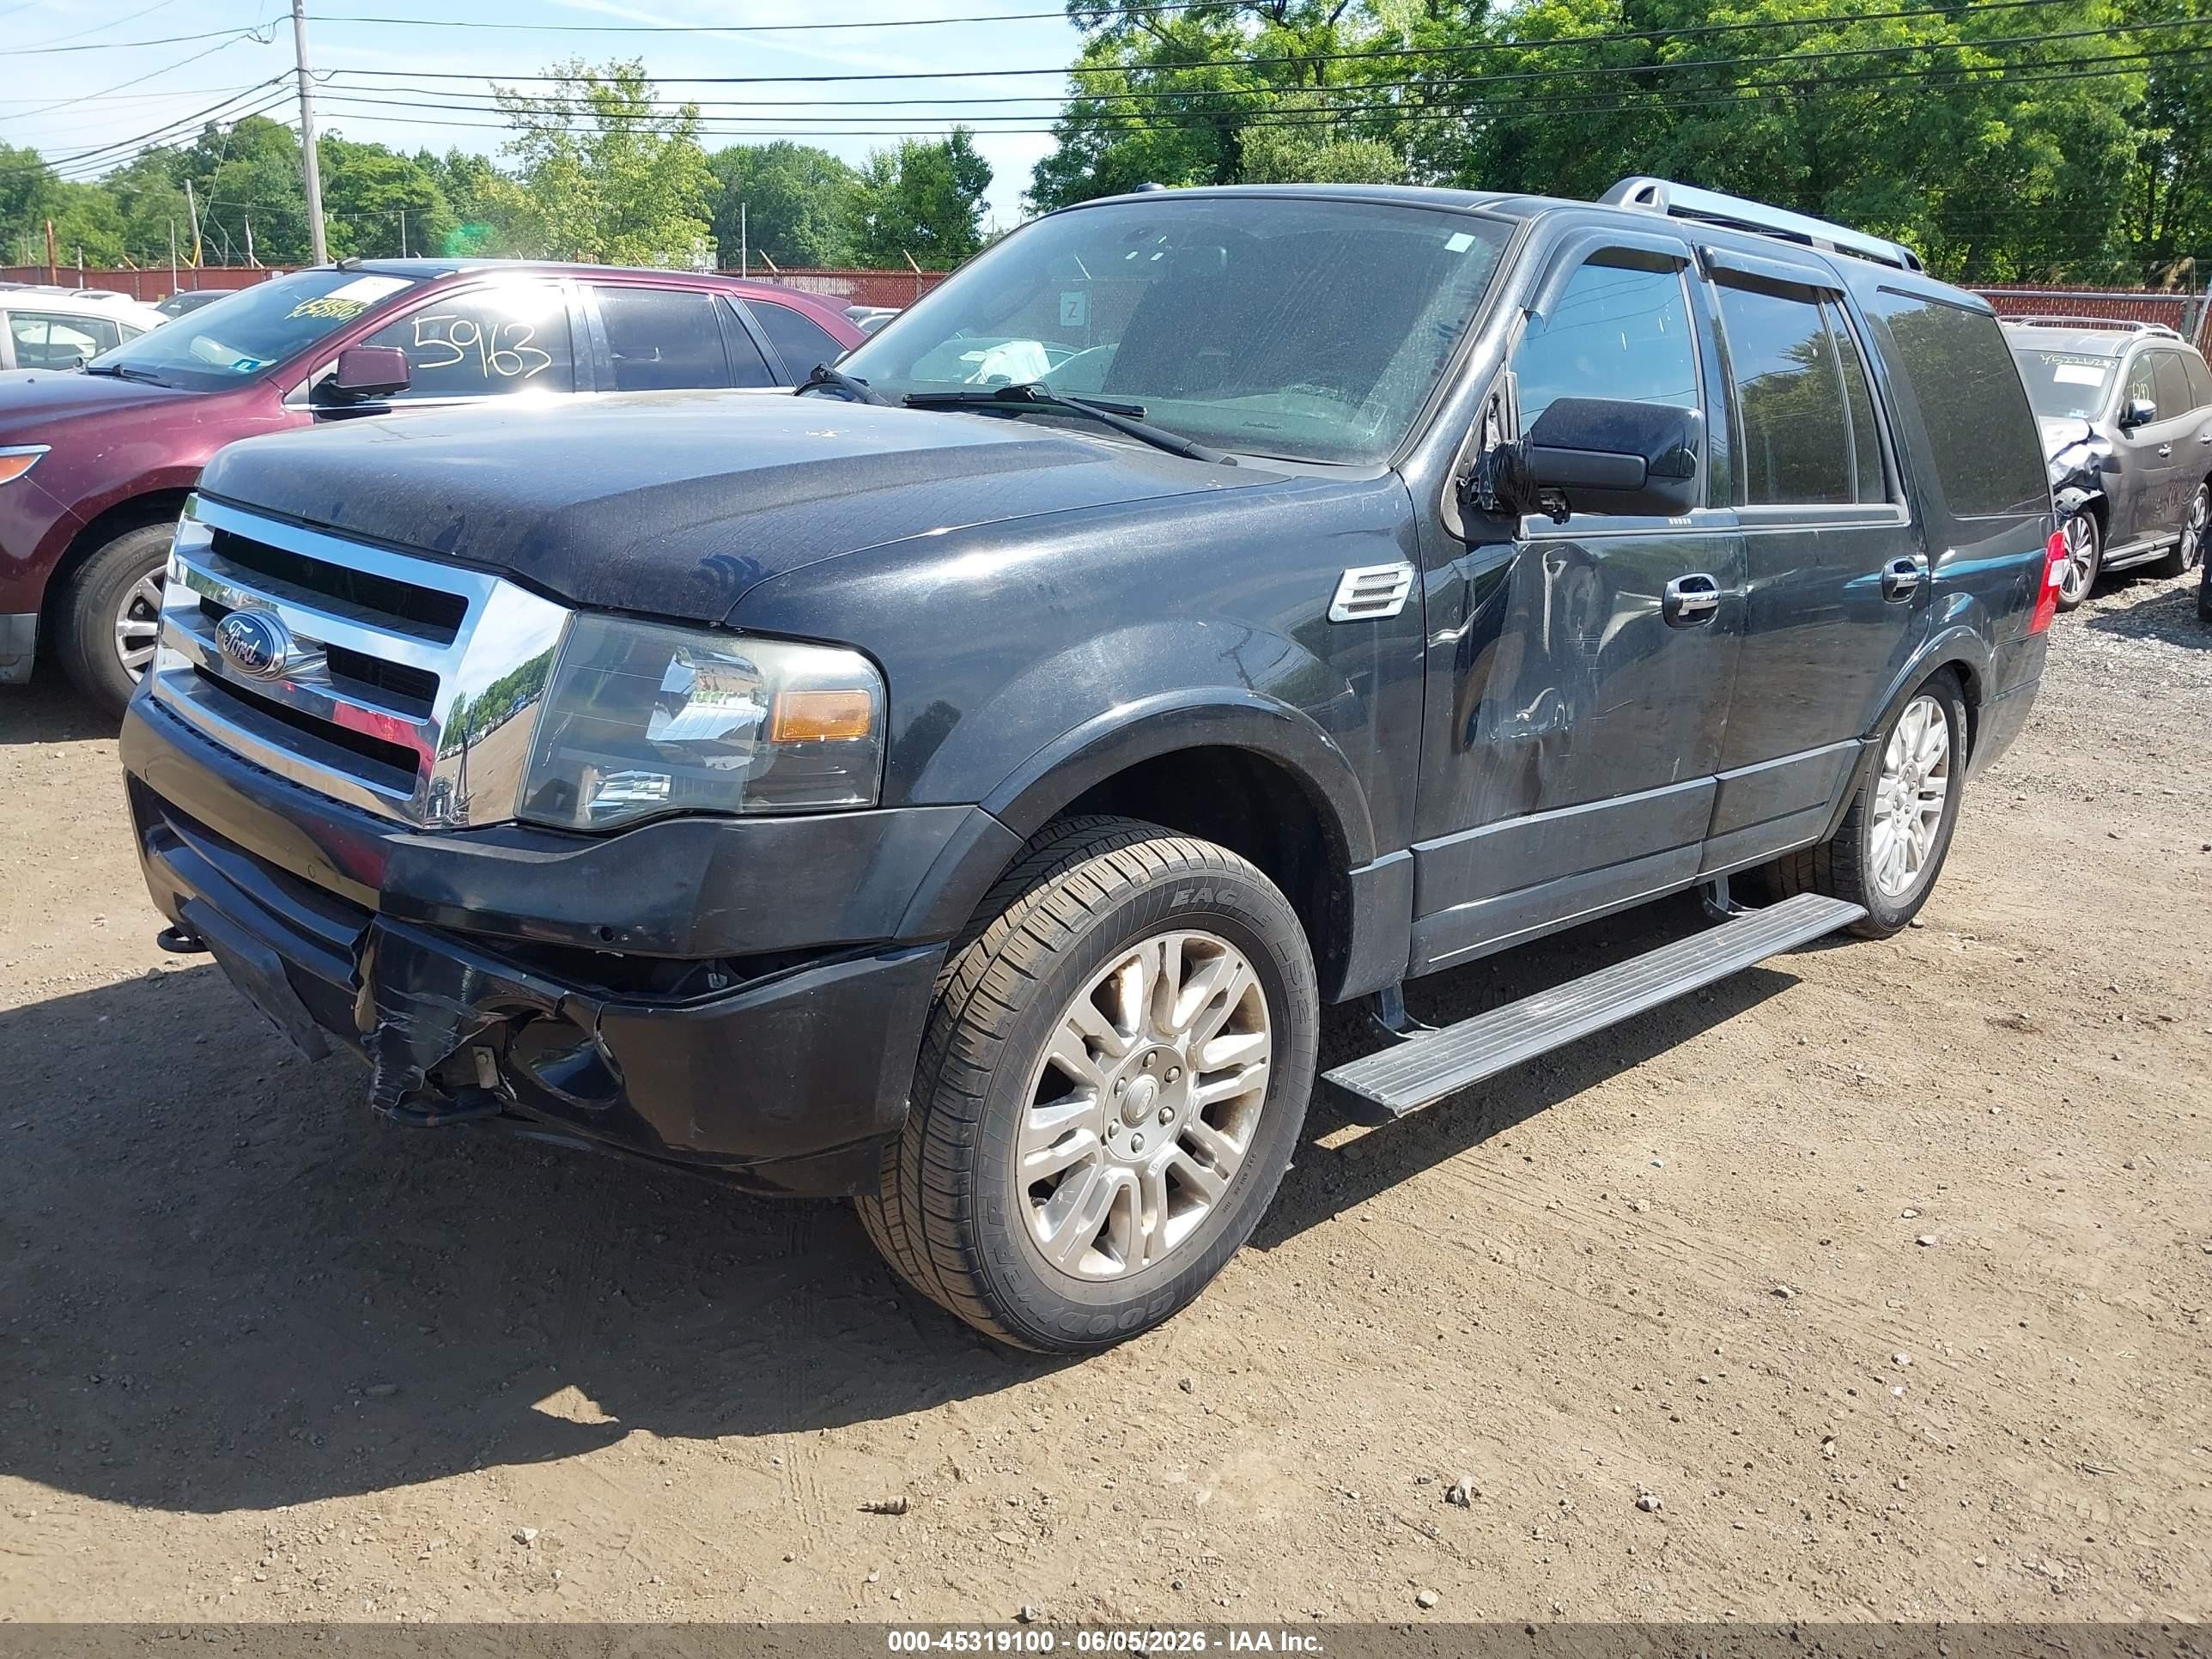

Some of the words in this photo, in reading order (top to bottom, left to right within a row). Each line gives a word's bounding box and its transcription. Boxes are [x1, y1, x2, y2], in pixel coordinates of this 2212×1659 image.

[411, 314, 552, 379] 5963
[222, 620, 260, 663] Ford
[1170, 888, 1273, 928] EAGLE
[987, 1199, 1176, 1334] GOODYEAR
